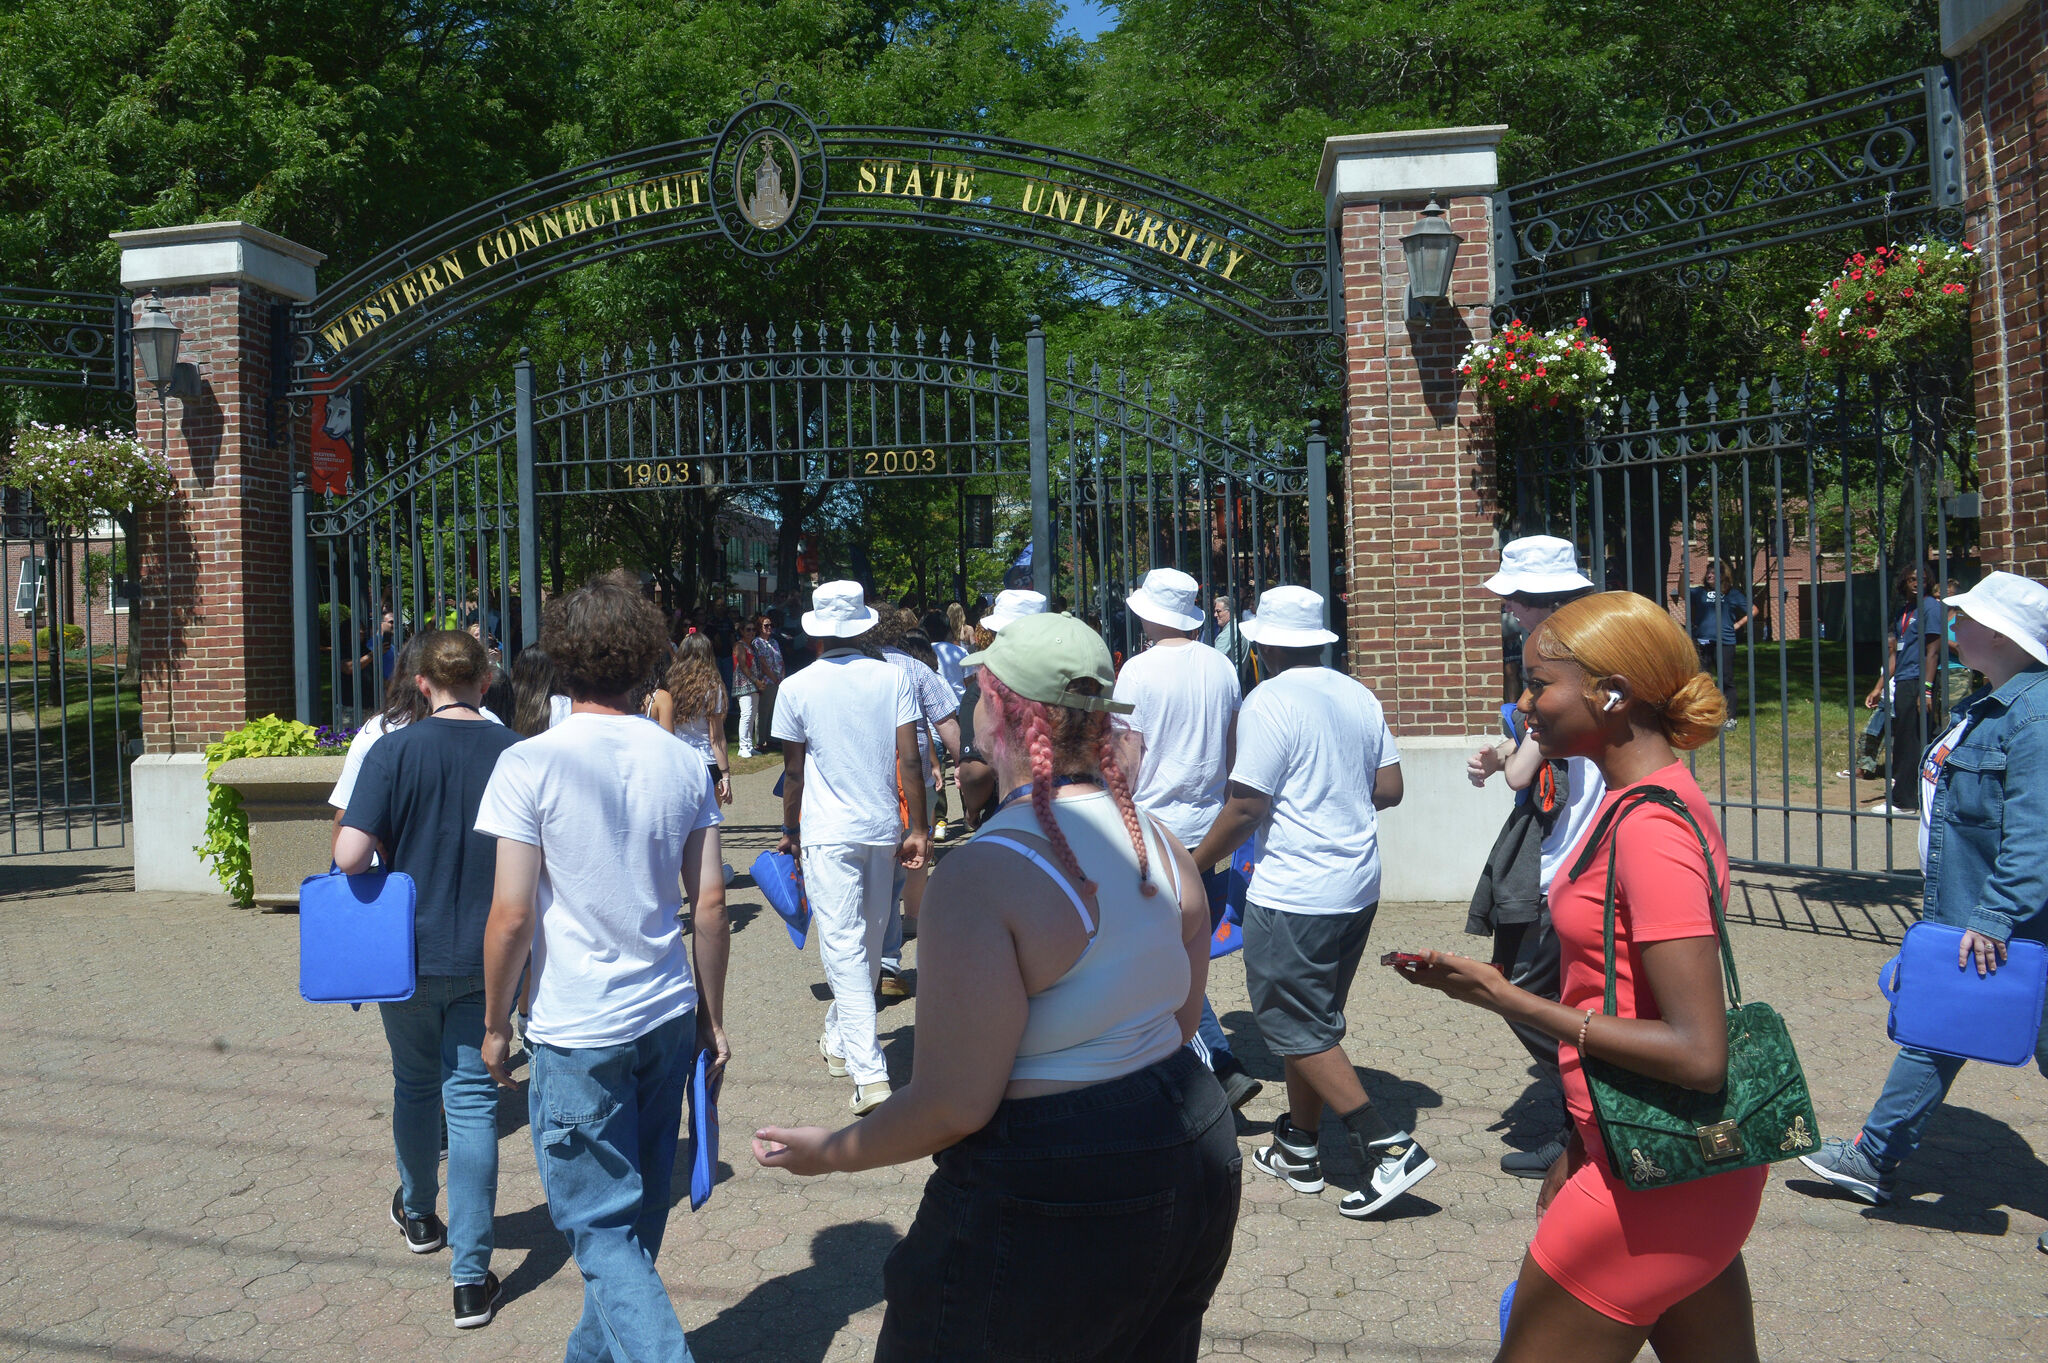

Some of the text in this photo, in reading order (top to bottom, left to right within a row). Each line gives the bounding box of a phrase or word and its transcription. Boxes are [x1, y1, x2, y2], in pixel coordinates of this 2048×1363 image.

[320, 159, 1251, 352] WESTERN CONNECTICUT STATE UNIVERSITY
[623, 462, 690, 486] 1903
[864, 449, 937, 475] 2003
